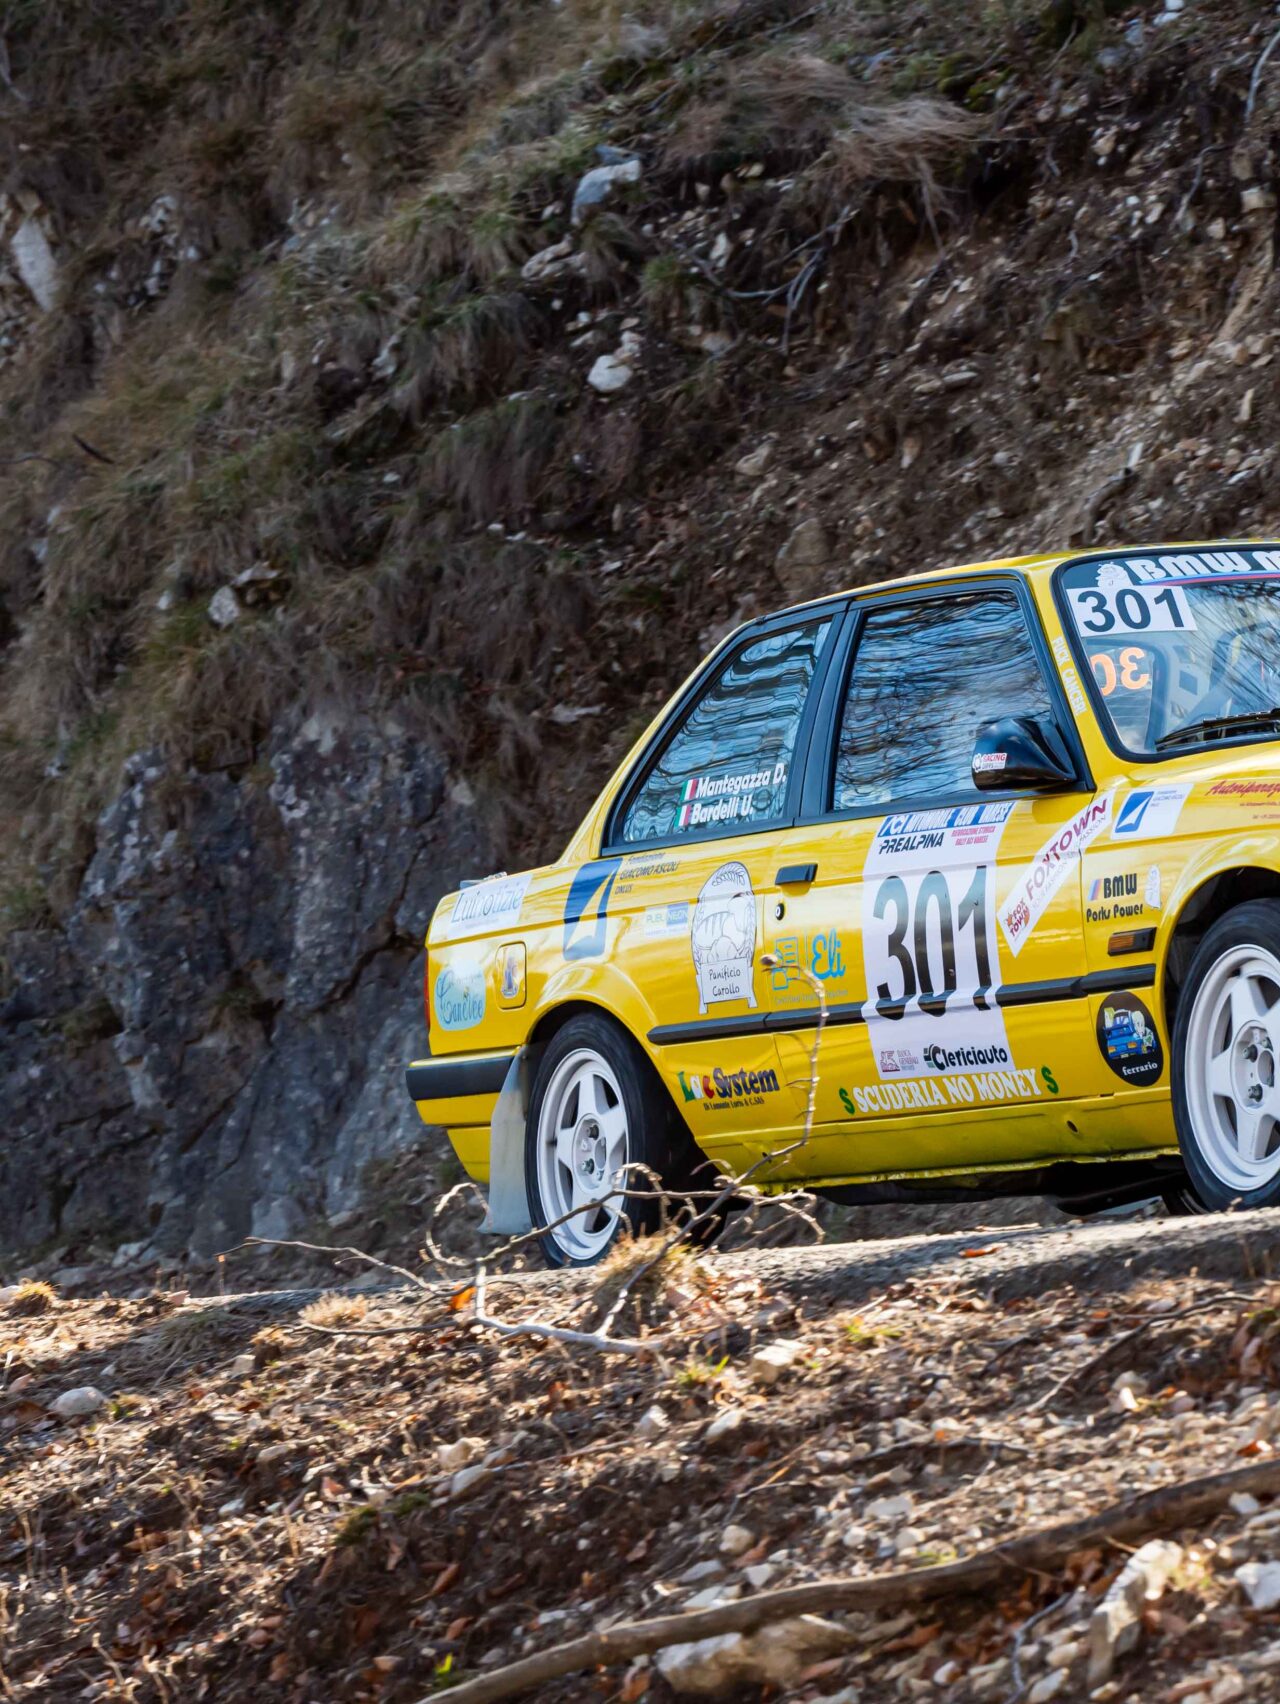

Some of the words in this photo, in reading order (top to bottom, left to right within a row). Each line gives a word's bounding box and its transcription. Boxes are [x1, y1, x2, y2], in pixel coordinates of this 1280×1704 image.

[1125, 551, 1252, 583] BMW
[1077, 588, 1185, 633] 301
[695, 774, 770, 799] Mantegazza
[772, 763, 788, 785] D.
[691, 798, 739, 825] Bardelli
[740, 797, 753, 818] U.
[879, 832, 945, 854] PREALPINA
[1025, 798, 1108, 901] FOXTOWN
[1103, 873, 1138, 899] BMW
[1010, 905, 1030, 937] TOWN
[1086, 907, 1110, 923] Porks
[1113, 904, 1144, 919] Power
[811, 928, 847, 980] Eli
[872, 864, 993, 1021] 301
[708, 967, 741, 982] Panificio
[712, 983, 740, 995] Carollo
[930, 1044, 1010, 1071] Clericiauto
[713, 1067, 780, 1099] System
[852, 1077, 949, 1113] SCUDERIA
[949, 1074, 976, 1104] NO
[976, 1068, 1042, 1101] MONEY
